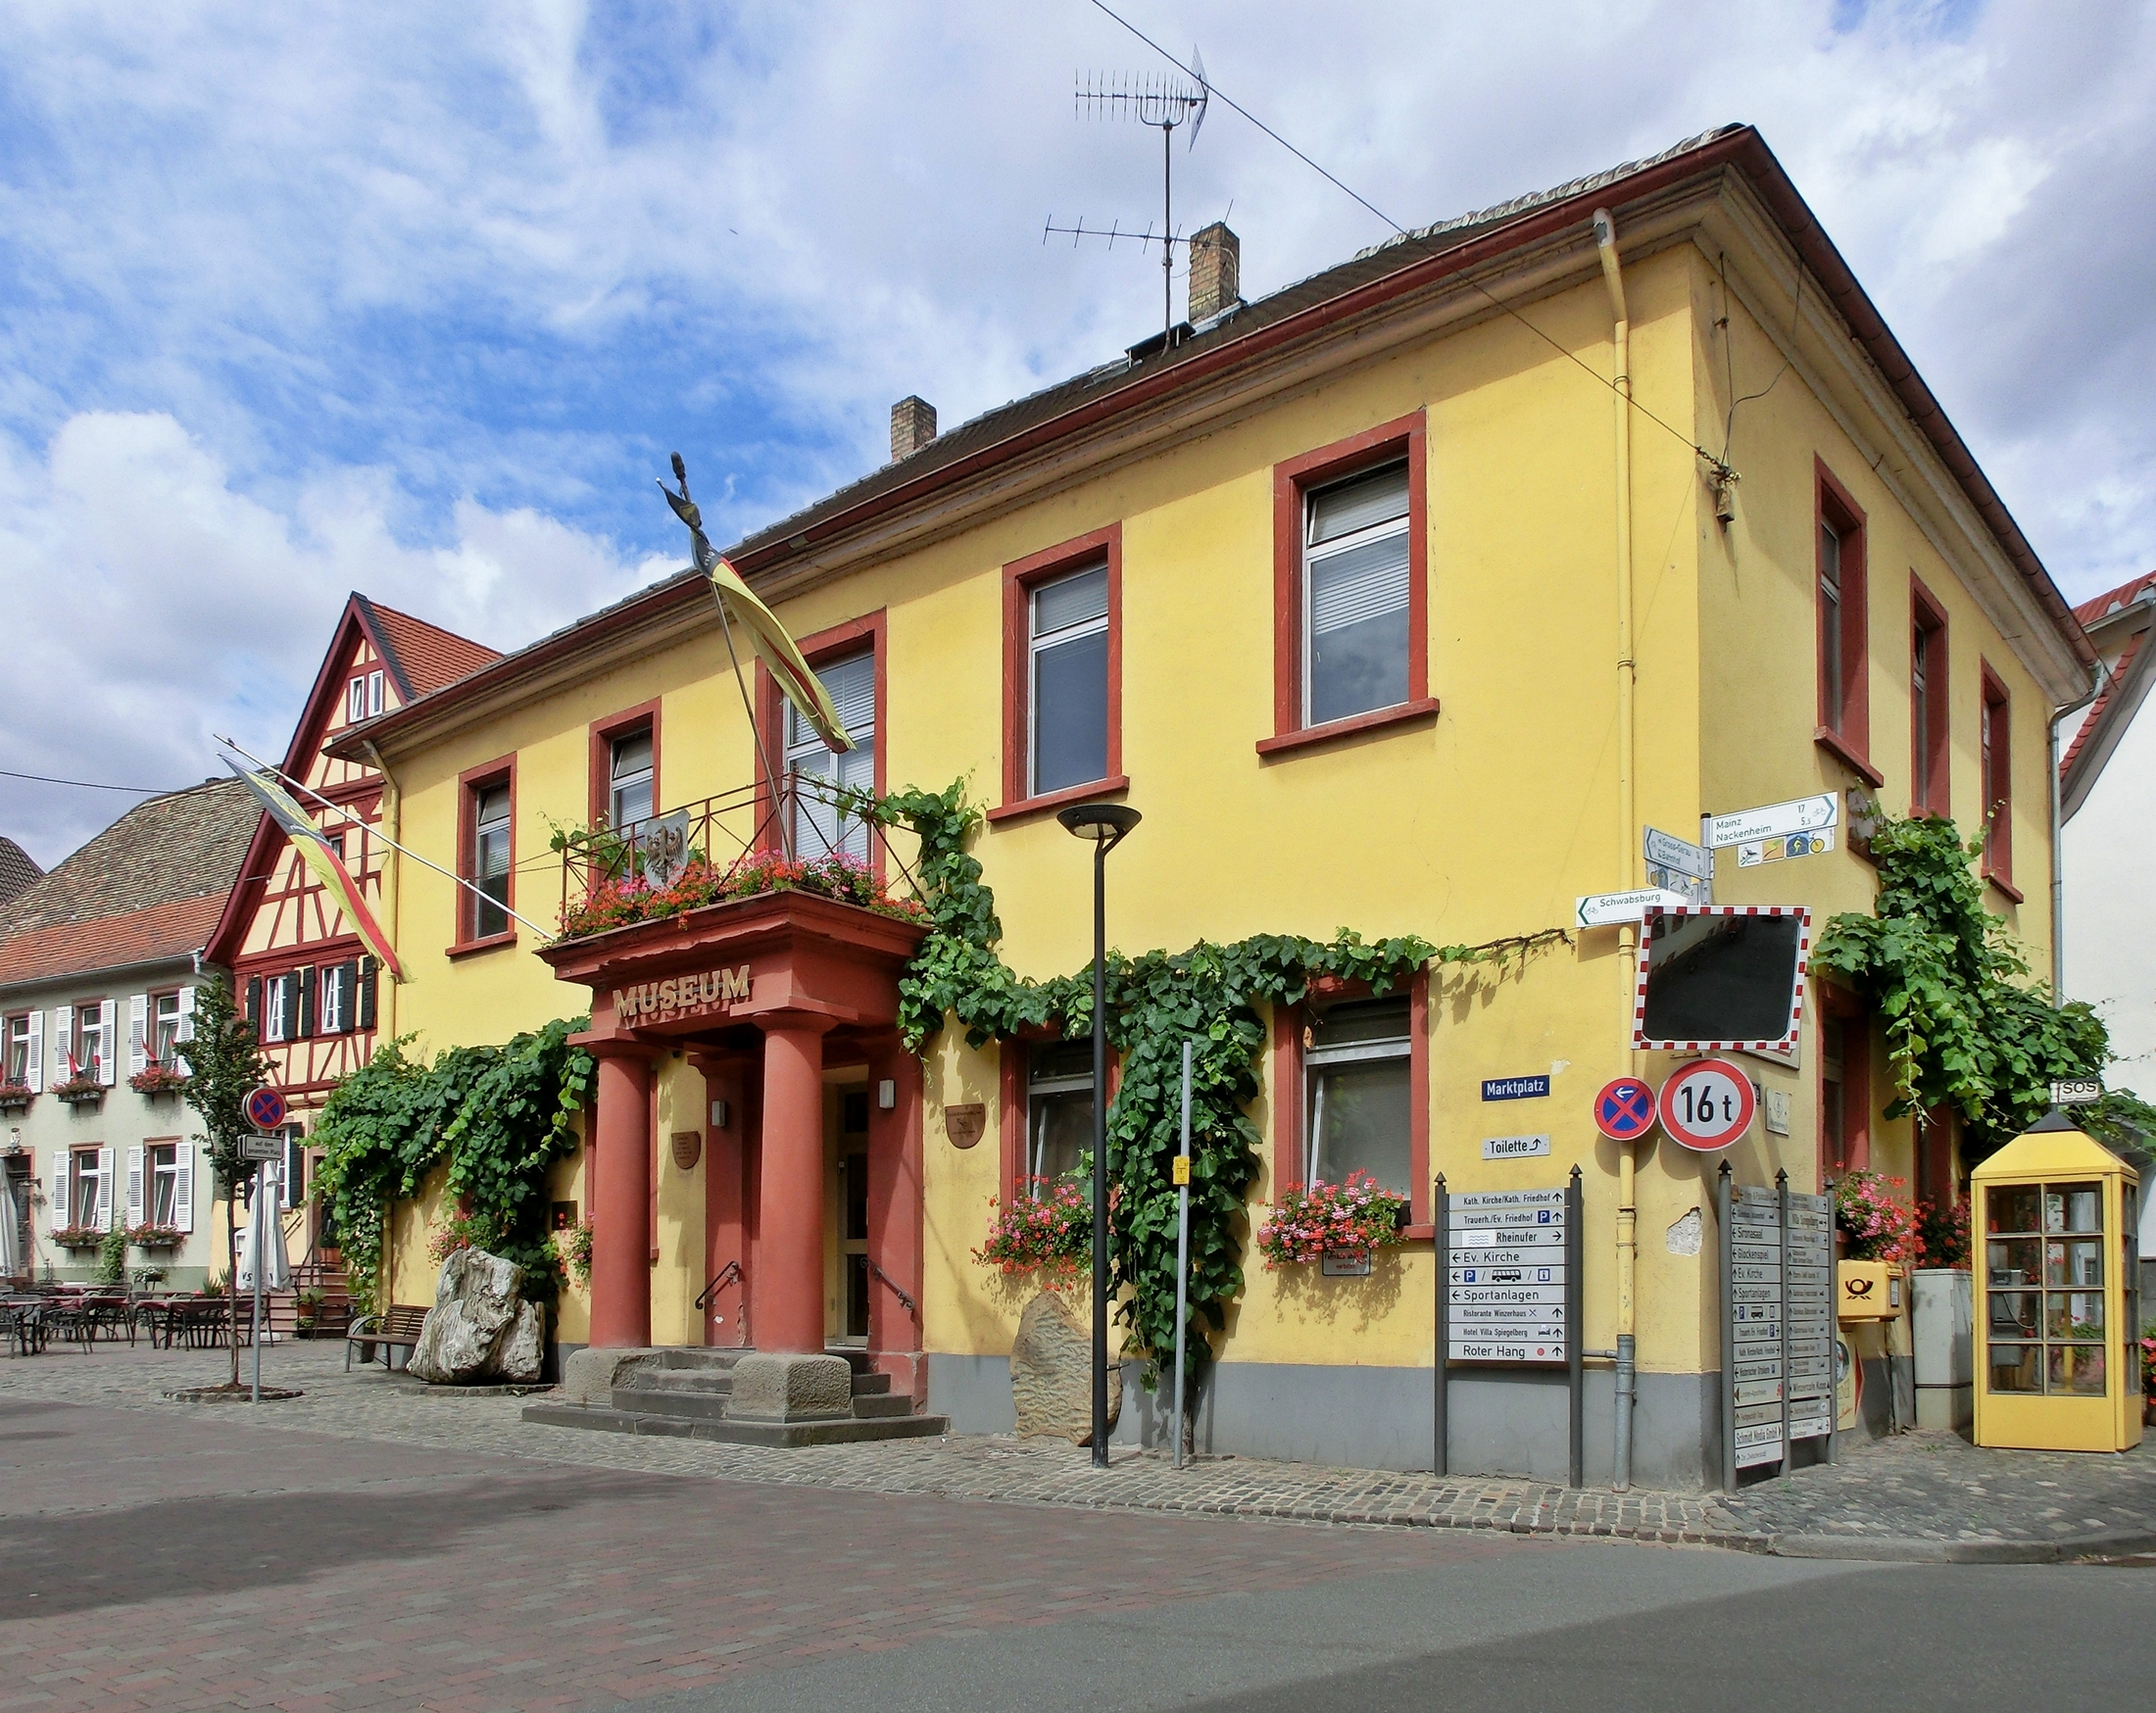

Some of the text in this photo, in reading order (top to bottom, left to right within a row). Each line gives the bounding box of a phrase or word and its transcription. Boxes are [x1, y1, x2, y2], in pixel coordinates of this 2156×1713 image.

[1716, 804, 1806, 830] Mainz 17
[1716, 824, 1772, 842] Nackenheim
[1599, 894, 1661, 907] Schwabsburg
[612, 963, 751, 1018] MUSEUM
[1487, 1079, 1544, 1097] Marktplatz
[2062, 1081, 2097, 1095] SOS
[1680, 1085, 1733, 1123] 16 t
[1490, 1140, 1528, 1154] Toilette
[1463, 1194, 1550, 1205] Kath. Kirche/Kath. Friedhof
[1505, 1213, 1534, 1223] Friedhof
[1496, 1232, 1538, 1243] Rheinufer
[1463, 1251, 1520, 1263] Ev. Kirche
[1464, 1290, 1540, 1302] Sportanlagen
[1738, 1287, 1771, 1300] Sportanlagen
[1494, 1329, 1528, 1338] Spiegelberg
[1463, 1346, 1525, 1359] Roter Hang
